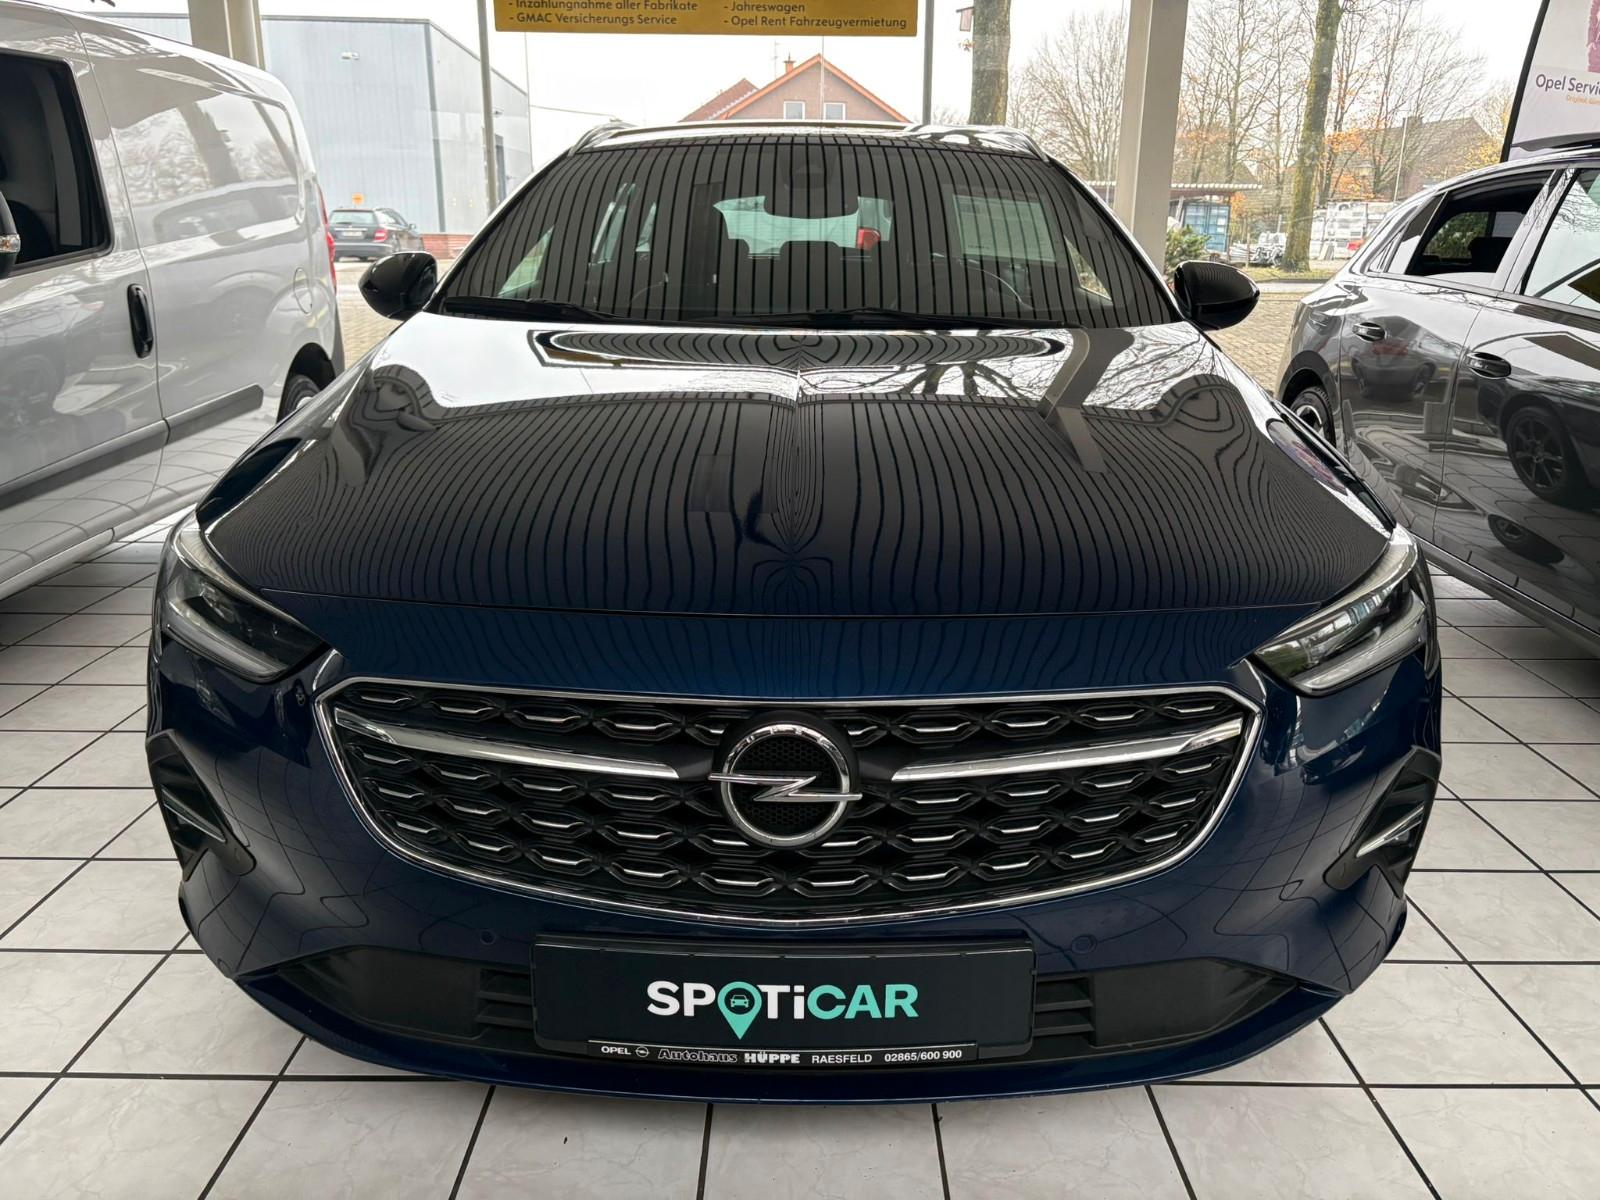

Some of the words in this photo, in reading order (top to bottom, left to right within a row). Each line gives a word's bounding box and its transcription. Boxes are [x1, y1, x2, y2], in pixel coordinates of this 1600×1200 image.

[615, 0, 641, 10] aller
[644, 0, 698, 11] Fabrikate
[731, 1, 805, 14] Jahreswagen
[516, 12, 552, 23] GMAC
[555, 13, 634, 26] Versicherungs
[637, 14, 677, 24] Service
[731, 15, 757, 28] Opel
[761, 16, 786, 26] Rent
[790, 16, 907, 29] Fahrzeugvermietung
[1535, 73, 1567, 92] Opel
[601, 1045, 632, 1056] OPEL
[657, 1048, 738, 1063] Autohaus
[744, 1050, 800, 1064] HÜPPE
[811, 1053, 873, 1064] RAESFELD
[884, 1051, 941, 1062] 02865/600
[942, 1049, 963, 1059] 900
